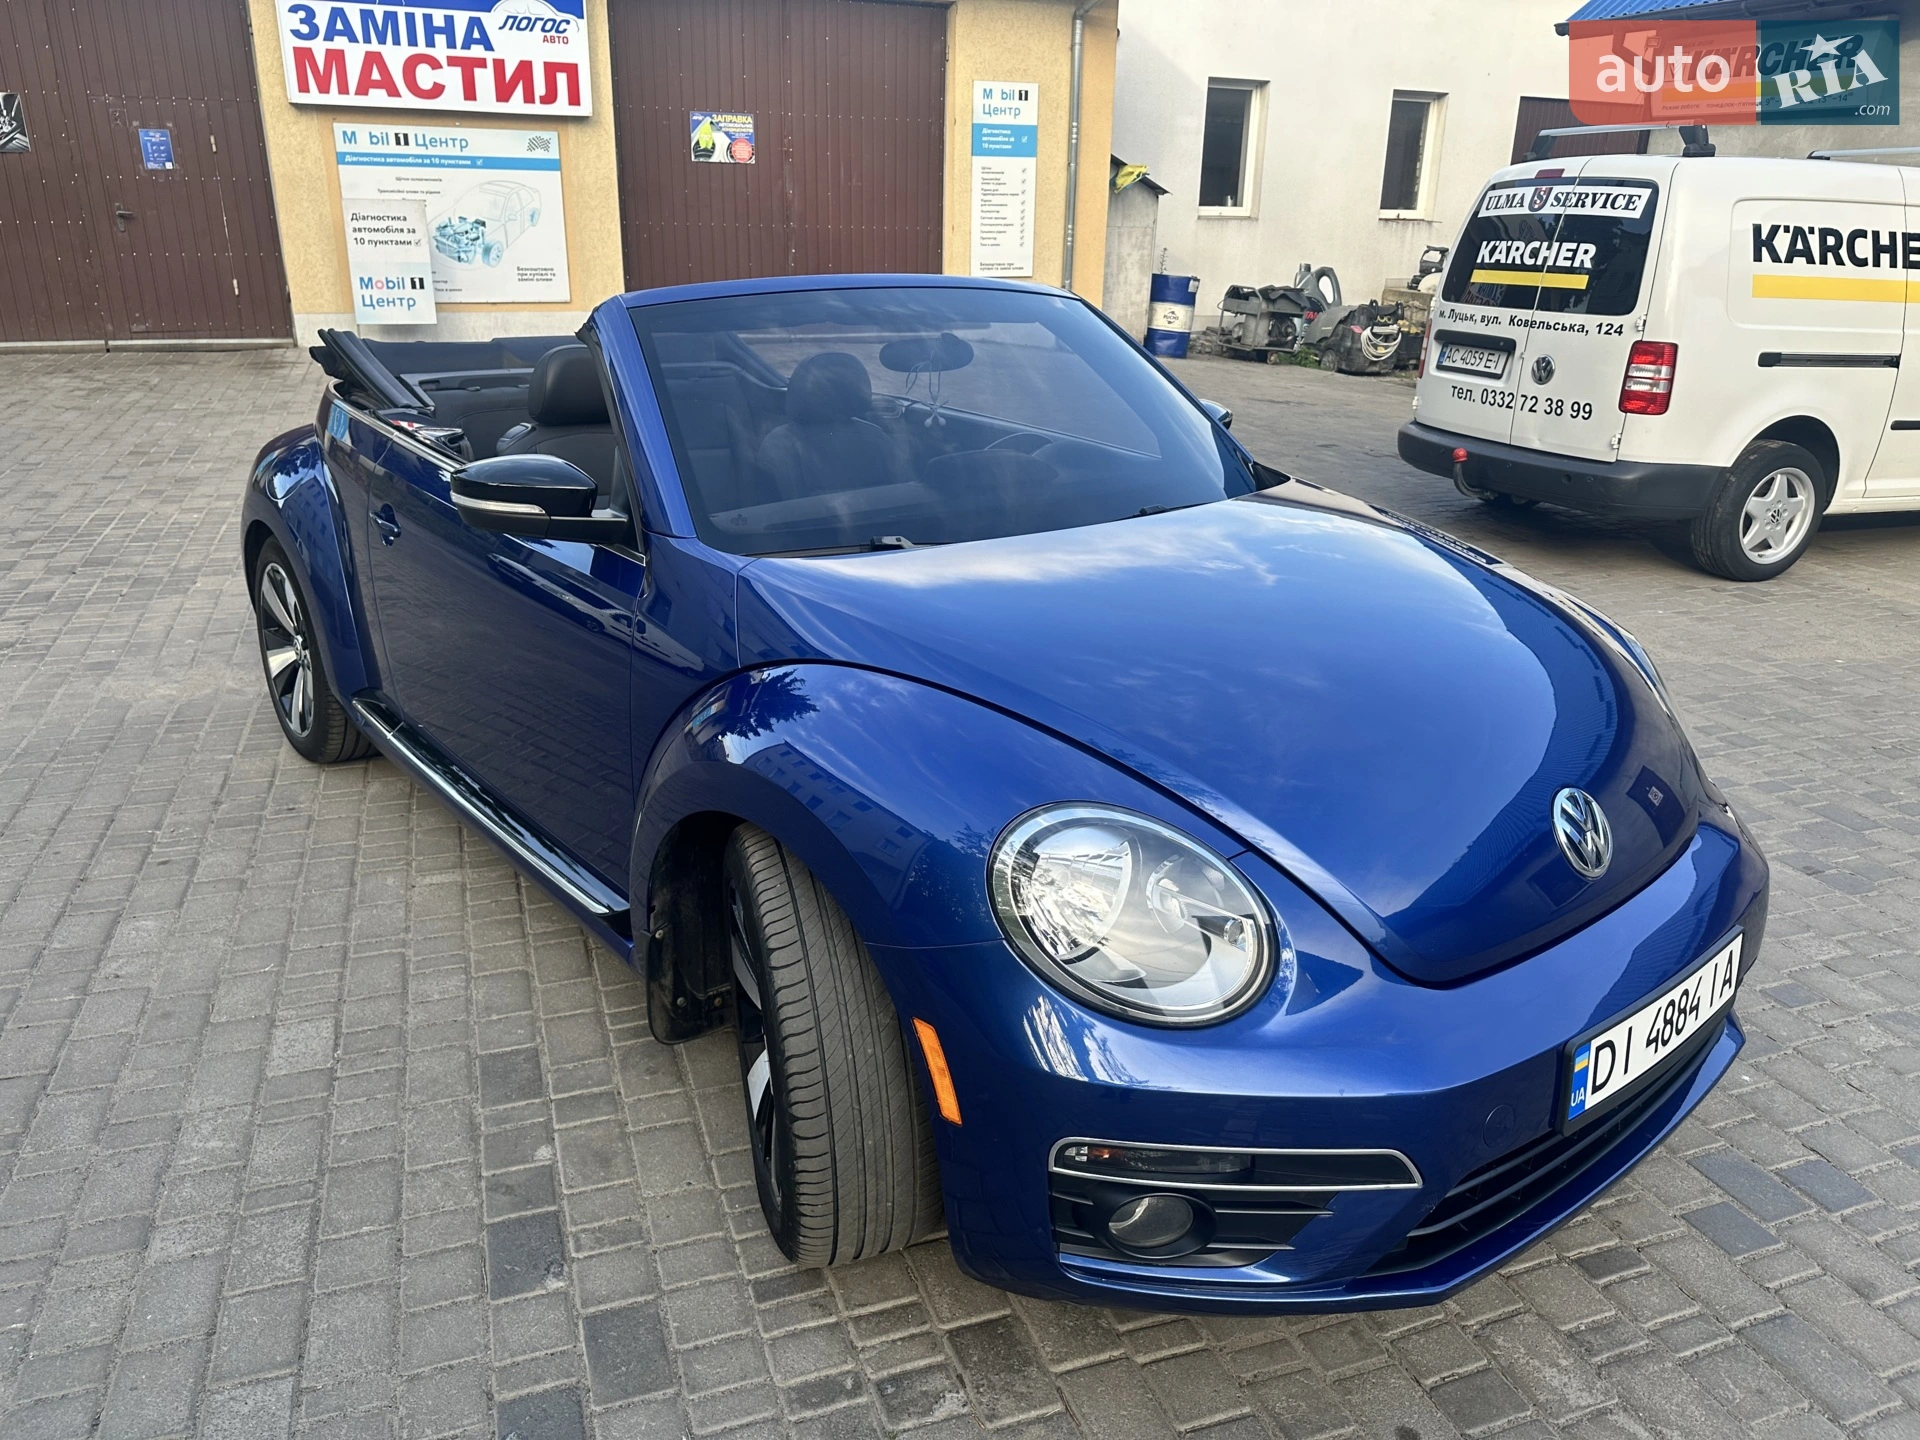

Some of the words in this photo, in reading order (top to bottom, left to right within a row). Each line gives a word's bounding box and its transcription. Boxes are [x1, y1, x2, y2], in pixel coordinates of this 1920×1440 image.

[287, 3, 495, 52] ЗАМІНА
[498, 14, 571, 34] ЛОГОС
[542, 34, 569, 45] АВТО
[292, 46, 582, 107] МАСТИЛ
[712, 114, 753, 123] ЗАПРАВКА
[982, 103, 1021, 120] Центр
[414, 133, 469, 151] Центр
[345, 154, 385, 164] Діагностика
[1485, 193, 1526, 211] ULMA
[1550, 191, 1642, 212] SERVICE
[350, 213, 407, 224] Діагностика
[352, 225, 405, 235] автомобіля
[406, 227, 416, 235] за
[354, 237, 365, 246] 10
[367, 239, 412, 247] пунктами
[1476, 240, 1597, 269] KÄRCHER
[359, 276, 406, 290] Mobil
[361, 294, 416, 311] Центр
[1447, 308, 1477, 325] Луцьк,
[1480, 313, 1502, 327] вул.
[1508, 314, 1590, 337] Ковельська,
[1595, 322, 1624, 337] 124
[1444, 347, 1460, 364] AC
[1460, 349, 1485, 368] 4059
[1451, 385, 1475, 403] тел.
[1480, 388, 1515, 410] 0332
[1520, 394, 1538, 413] 72
[1544, 398, 1564, 417] 38
[1570, 401, 1593, 421] 99
[1591, 1025, 1633, 1096] DI
[1645, 975, 1703, 1055] 4884
[1709, 949, 1734, 1010] IA
[1571, 1086, 1585, 1107] UA
